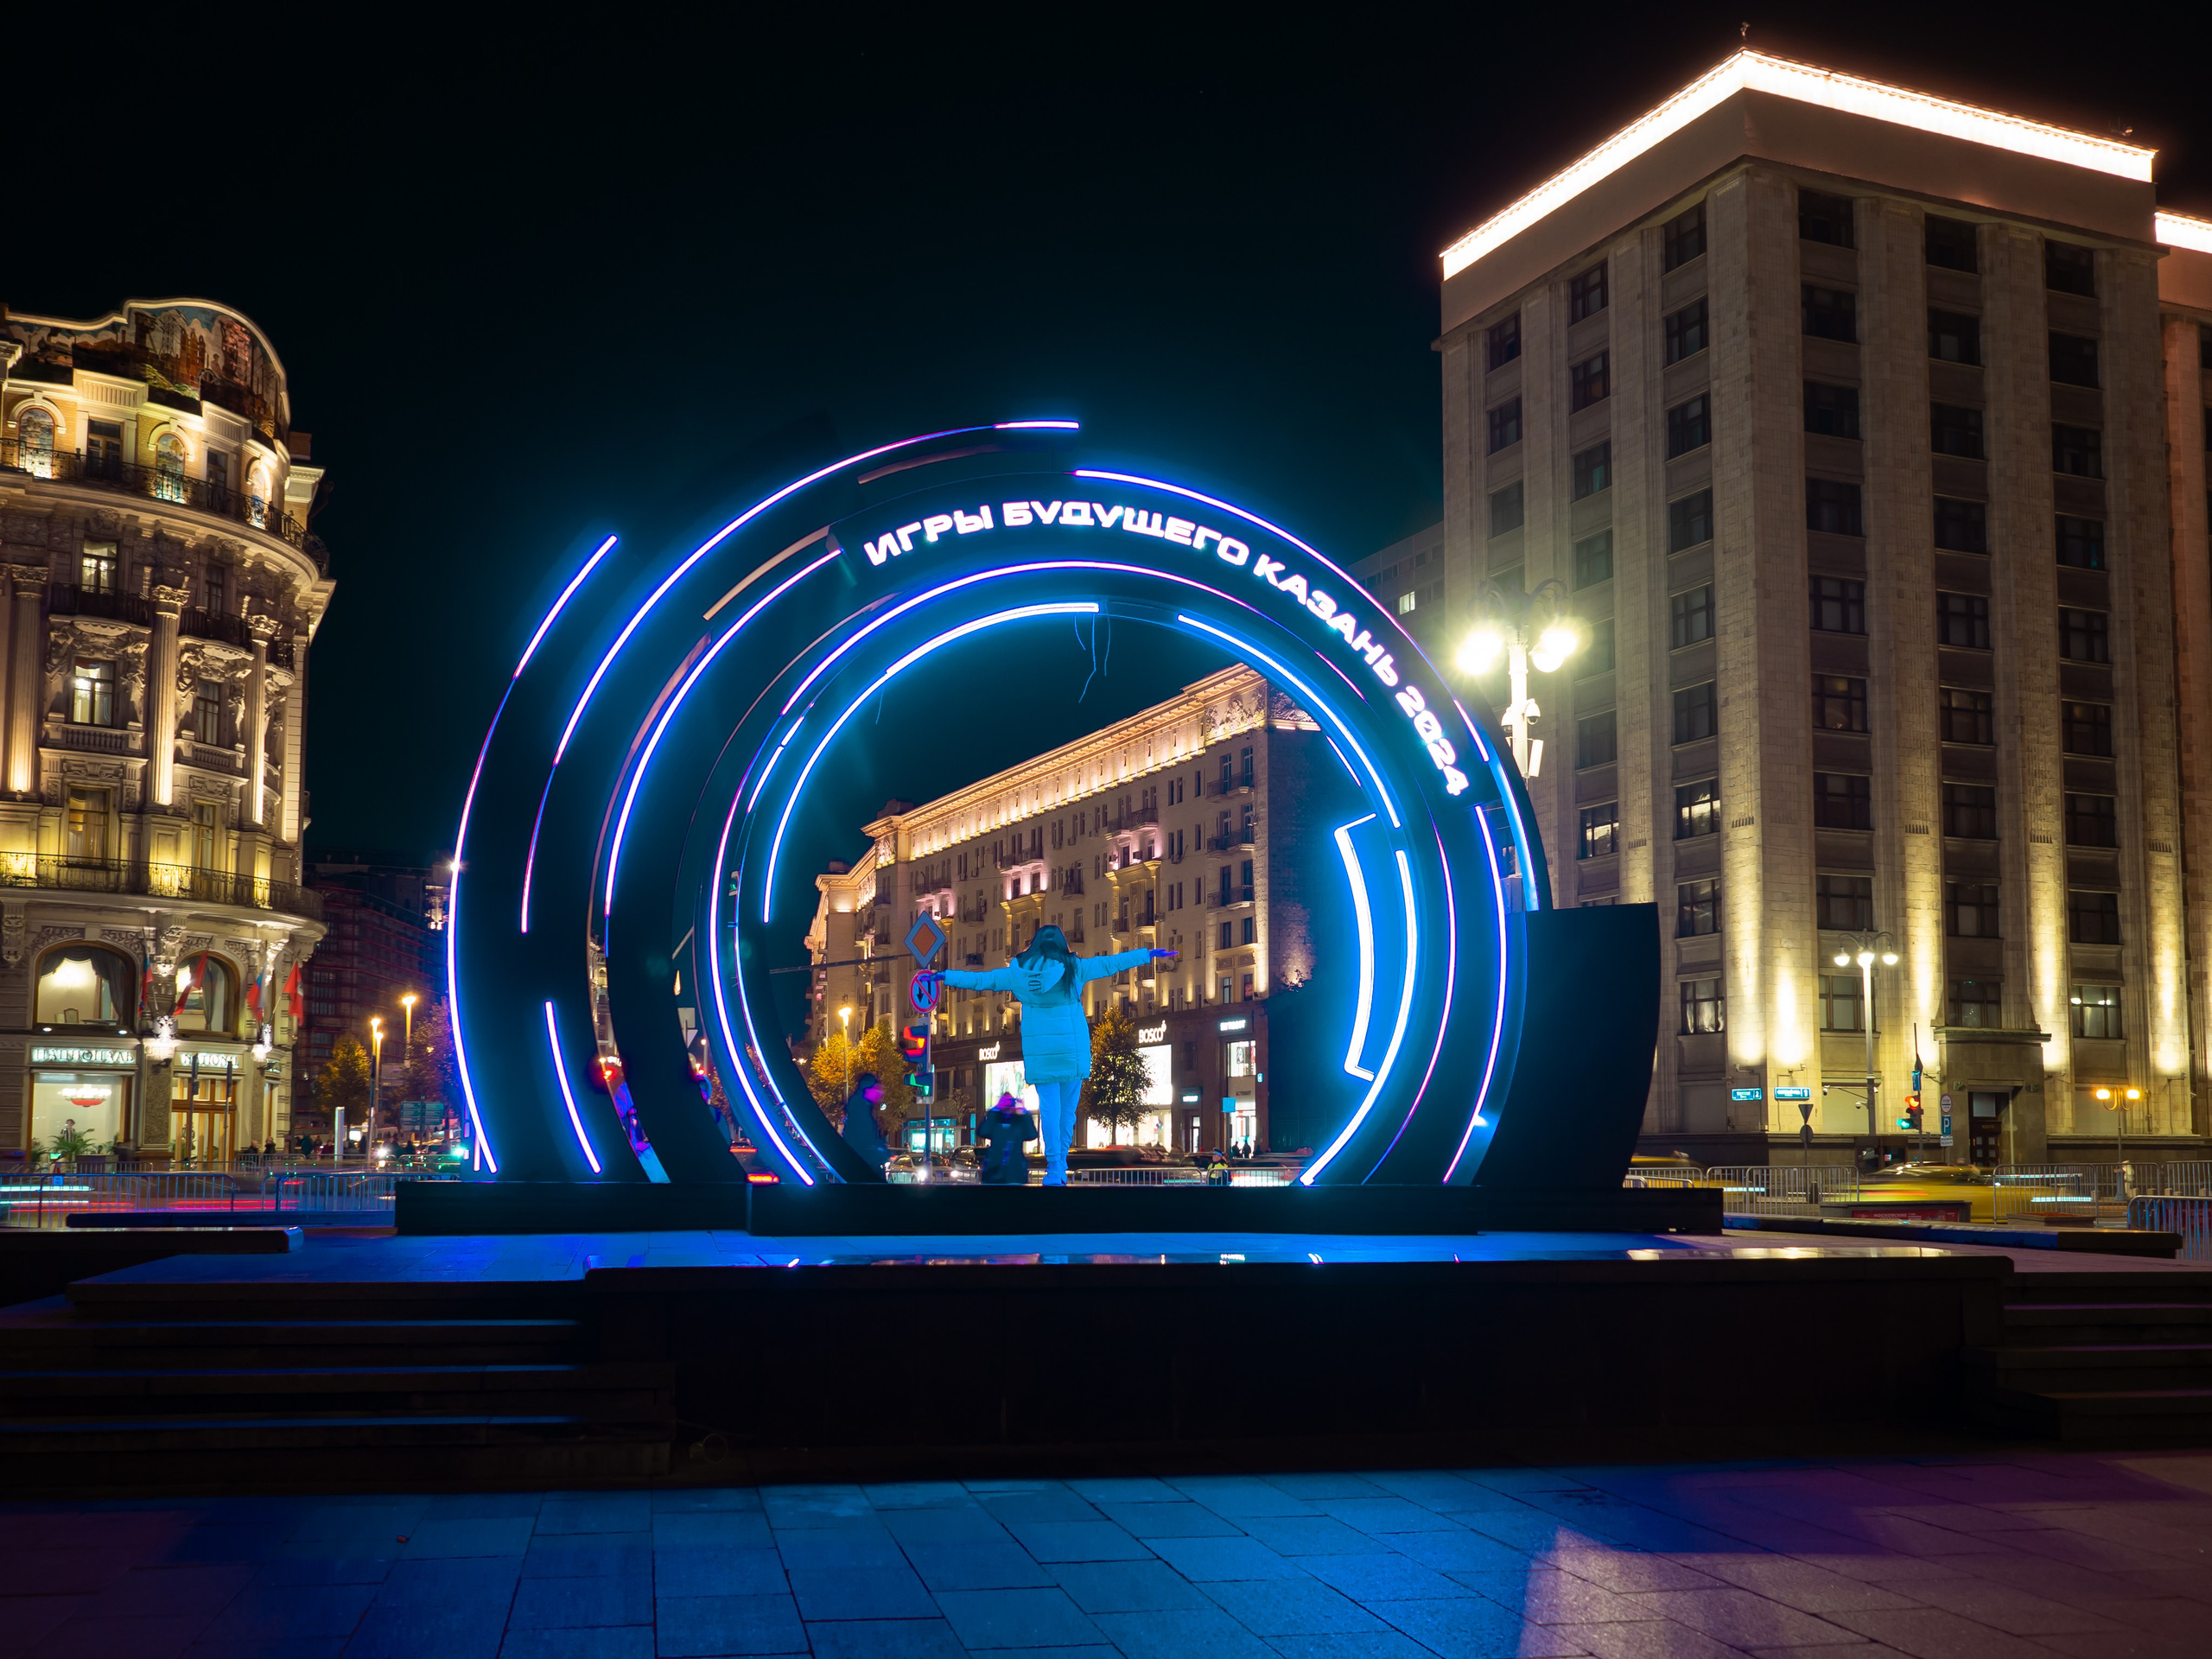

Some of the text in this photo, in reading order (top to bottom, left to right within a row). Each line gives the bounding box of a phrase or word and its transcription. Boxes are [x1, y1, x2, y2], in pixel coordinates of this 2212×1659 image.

[863, 500, 1470, 796] ИГРЫ БУДУЩЕГО КАЗАНЬ 2024
[1139, 1027, 1164, 1044] BOSCO
[34, 1047, 136, 1063] НАЦИОНАЛЬ
[978, 1047, 999, 1061] BOSCO
